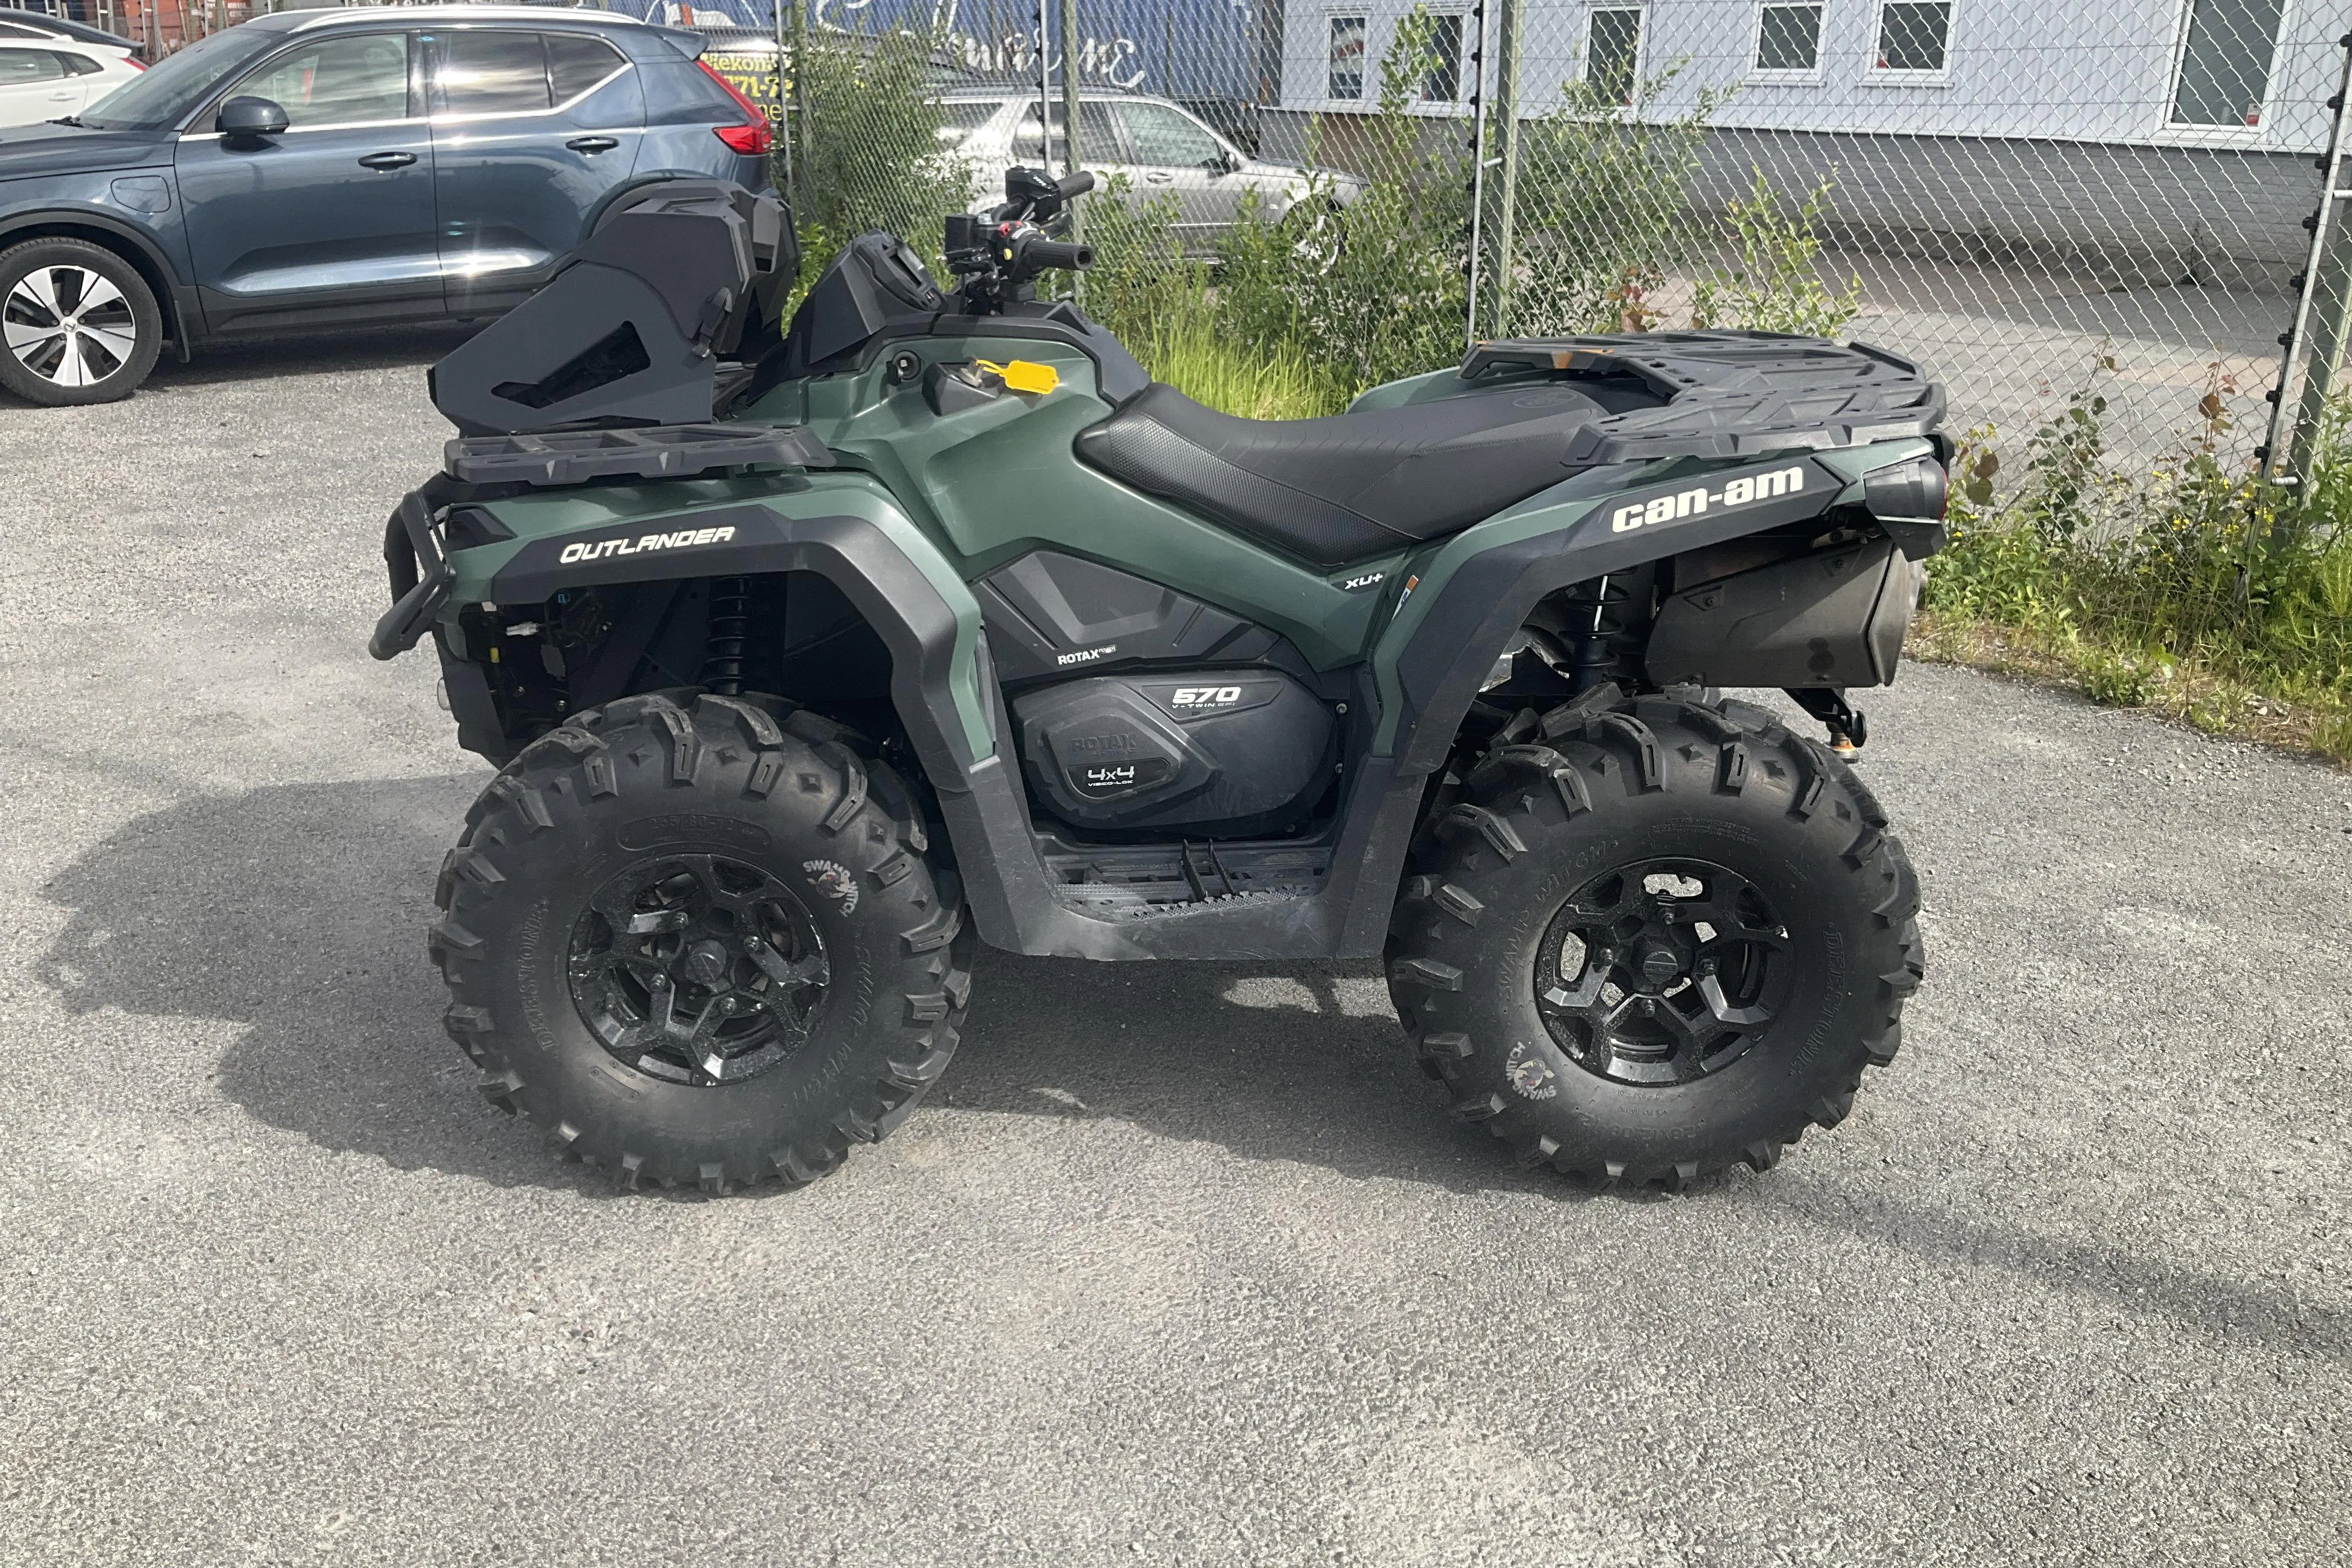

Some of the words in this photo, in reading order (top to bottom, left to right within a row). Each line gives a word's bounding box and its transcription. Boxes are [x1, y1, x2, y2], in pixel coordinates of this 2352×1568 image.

[1612, 467, 1803, 533] can-am
[560, 526, 735, 564] OUTLANDER
[1345, 573, 1383, 590] XU+
[1058, 649, 1100, 665] ROTAX
[1172, 687, 1241, 704] 570
[1071, 733, 1137, 752] ROTAX
[1087, 766, 1135, 780] 4x4
[803, 860, 850, 878] SWAMP
[838, 880, 859, 918] WITCH
[1505, 1041, 1526, 1081] WITCH
[1511, 1083, 1557, 1100] SWAMP
